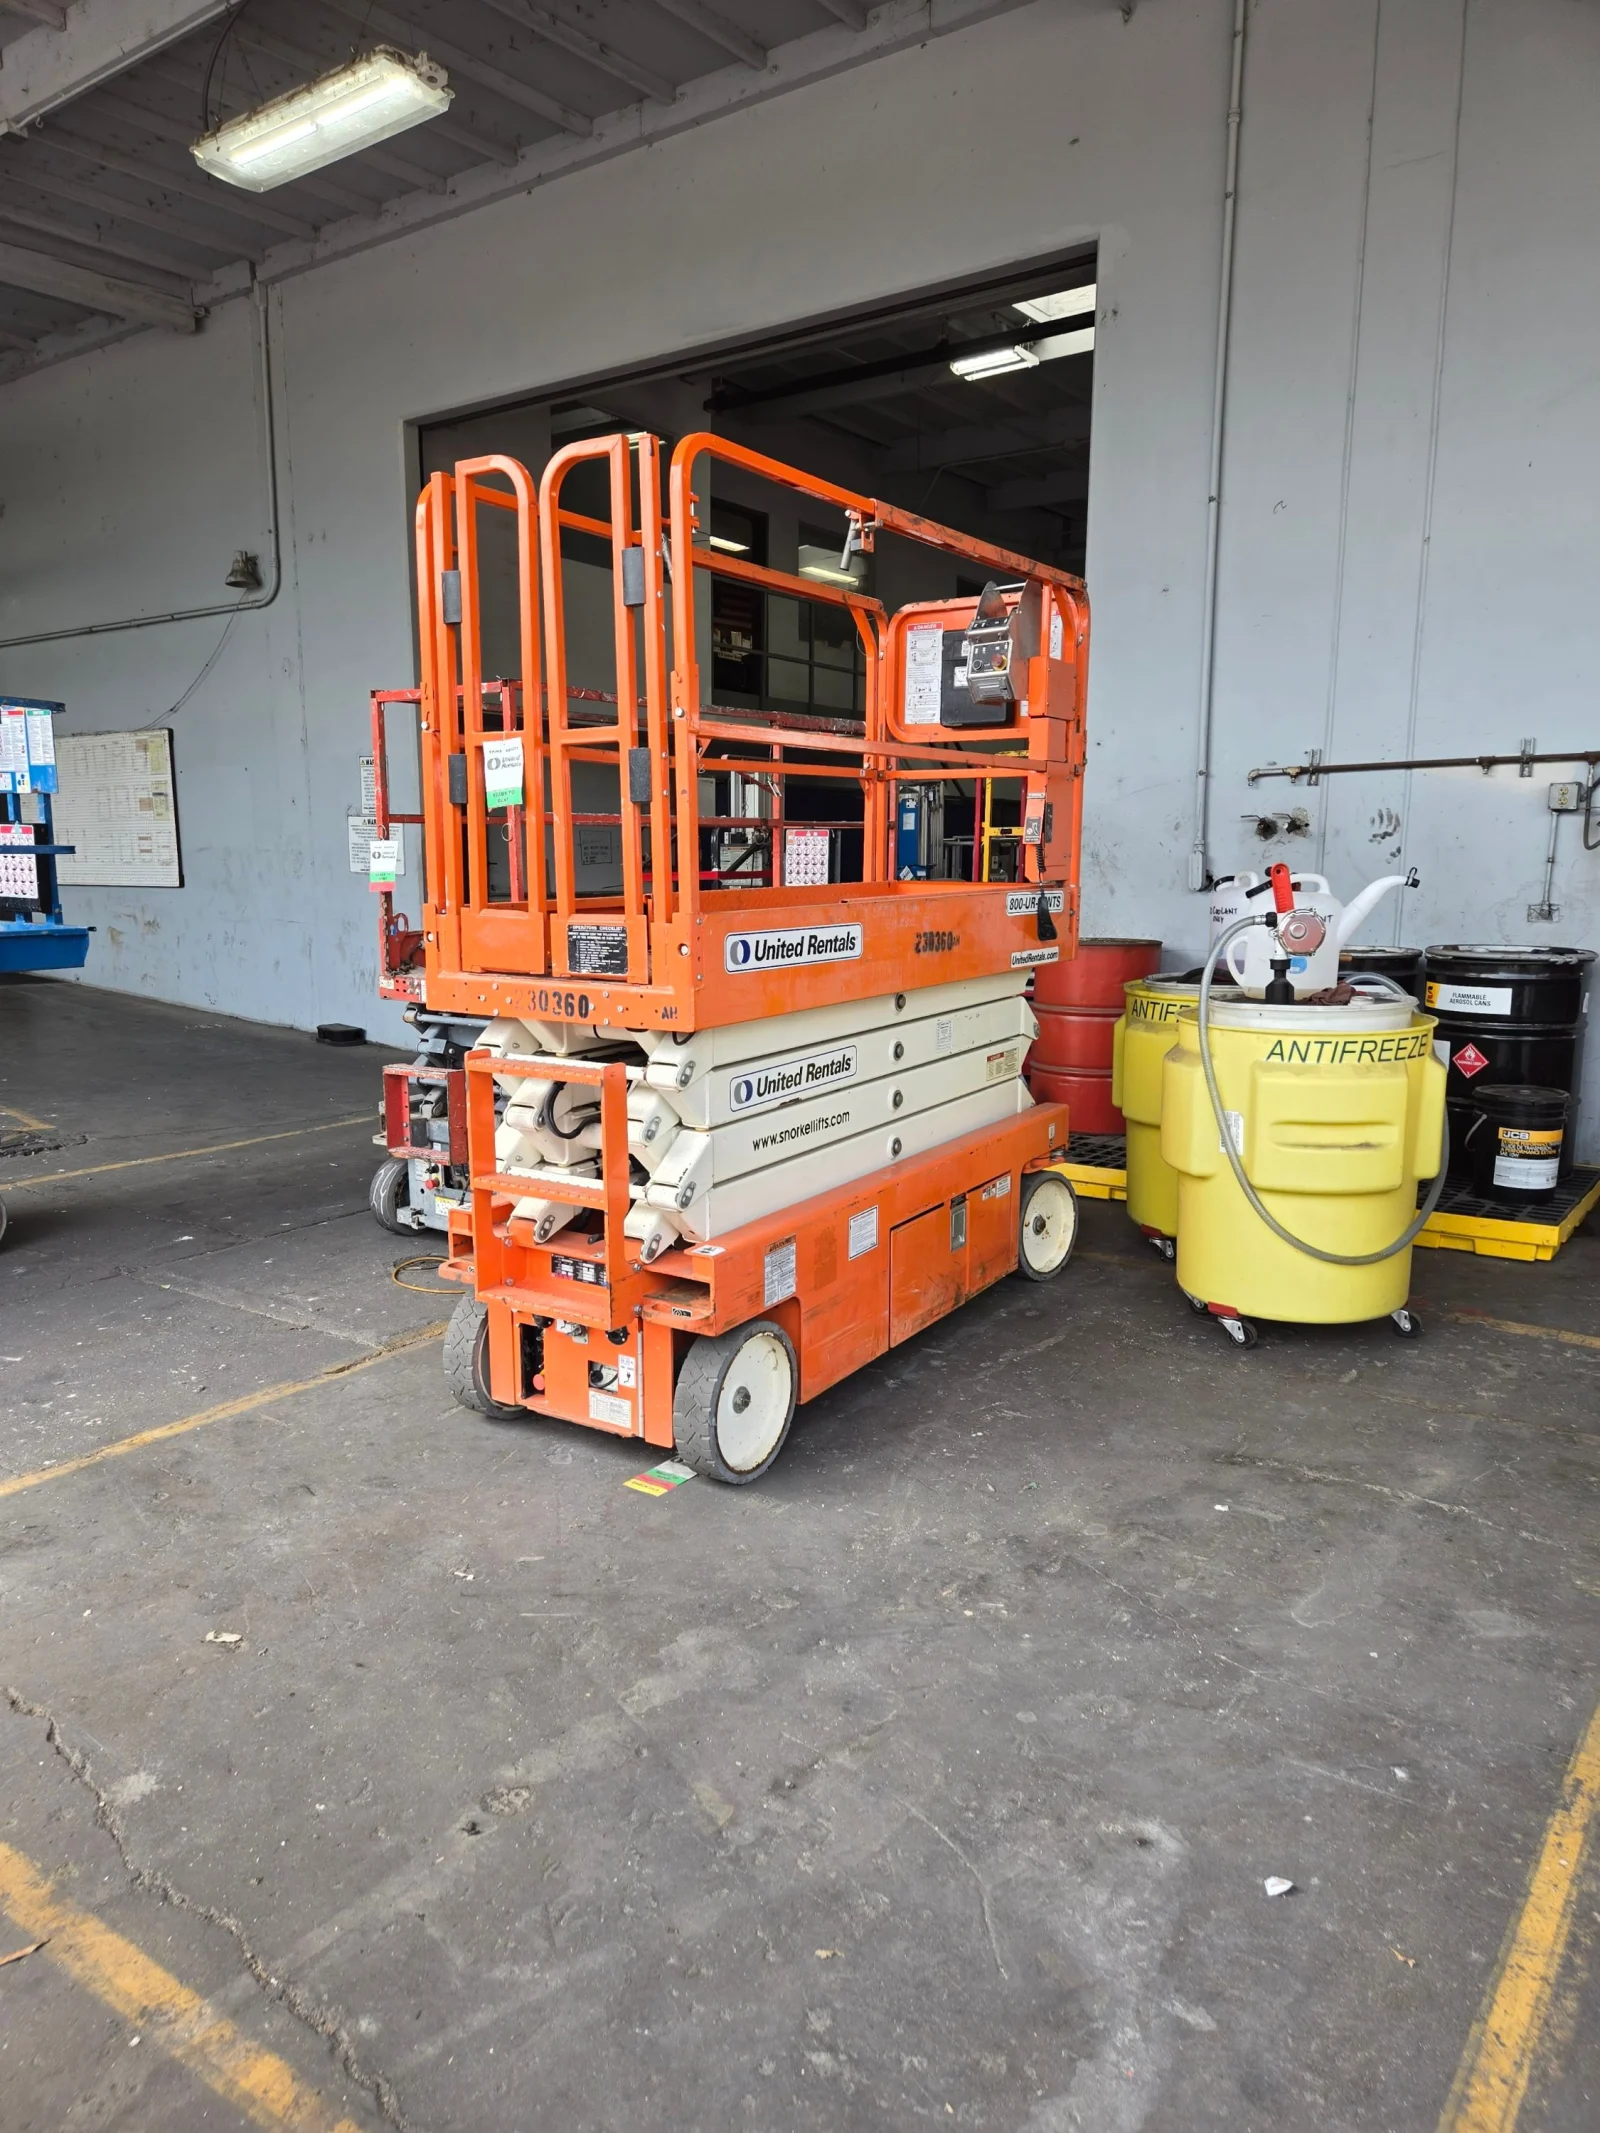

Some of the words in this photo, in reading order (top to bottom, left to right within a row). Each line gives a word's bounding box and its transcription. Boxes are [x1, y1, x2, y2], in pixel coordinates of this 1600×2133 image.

[1009, 895, 1061, 911] 800-UR-NTS
[754, 935, 805, 962] United
[807, 931, 857, 956] Rentals
[914, 930, 953, 954] 230360
[1011, 951, 1058, 966] UnitedRentals.com
[1449, 998, 1473, 1006] AEROSOL
[1452, 992, 1487, 1000] FLAMMABLE
[1131, 998, 1191, 1024] ANTIF
[1265, 1033, 1429, 1064] ANTIFREEZE
[756, 1066, 804, 1098] United
[805, 1053, 852, 1083] Rentals
[752, 1111, 850, 1151] www.snorkellifts.com
[1503, 1130, 1530, 1140] JCB
